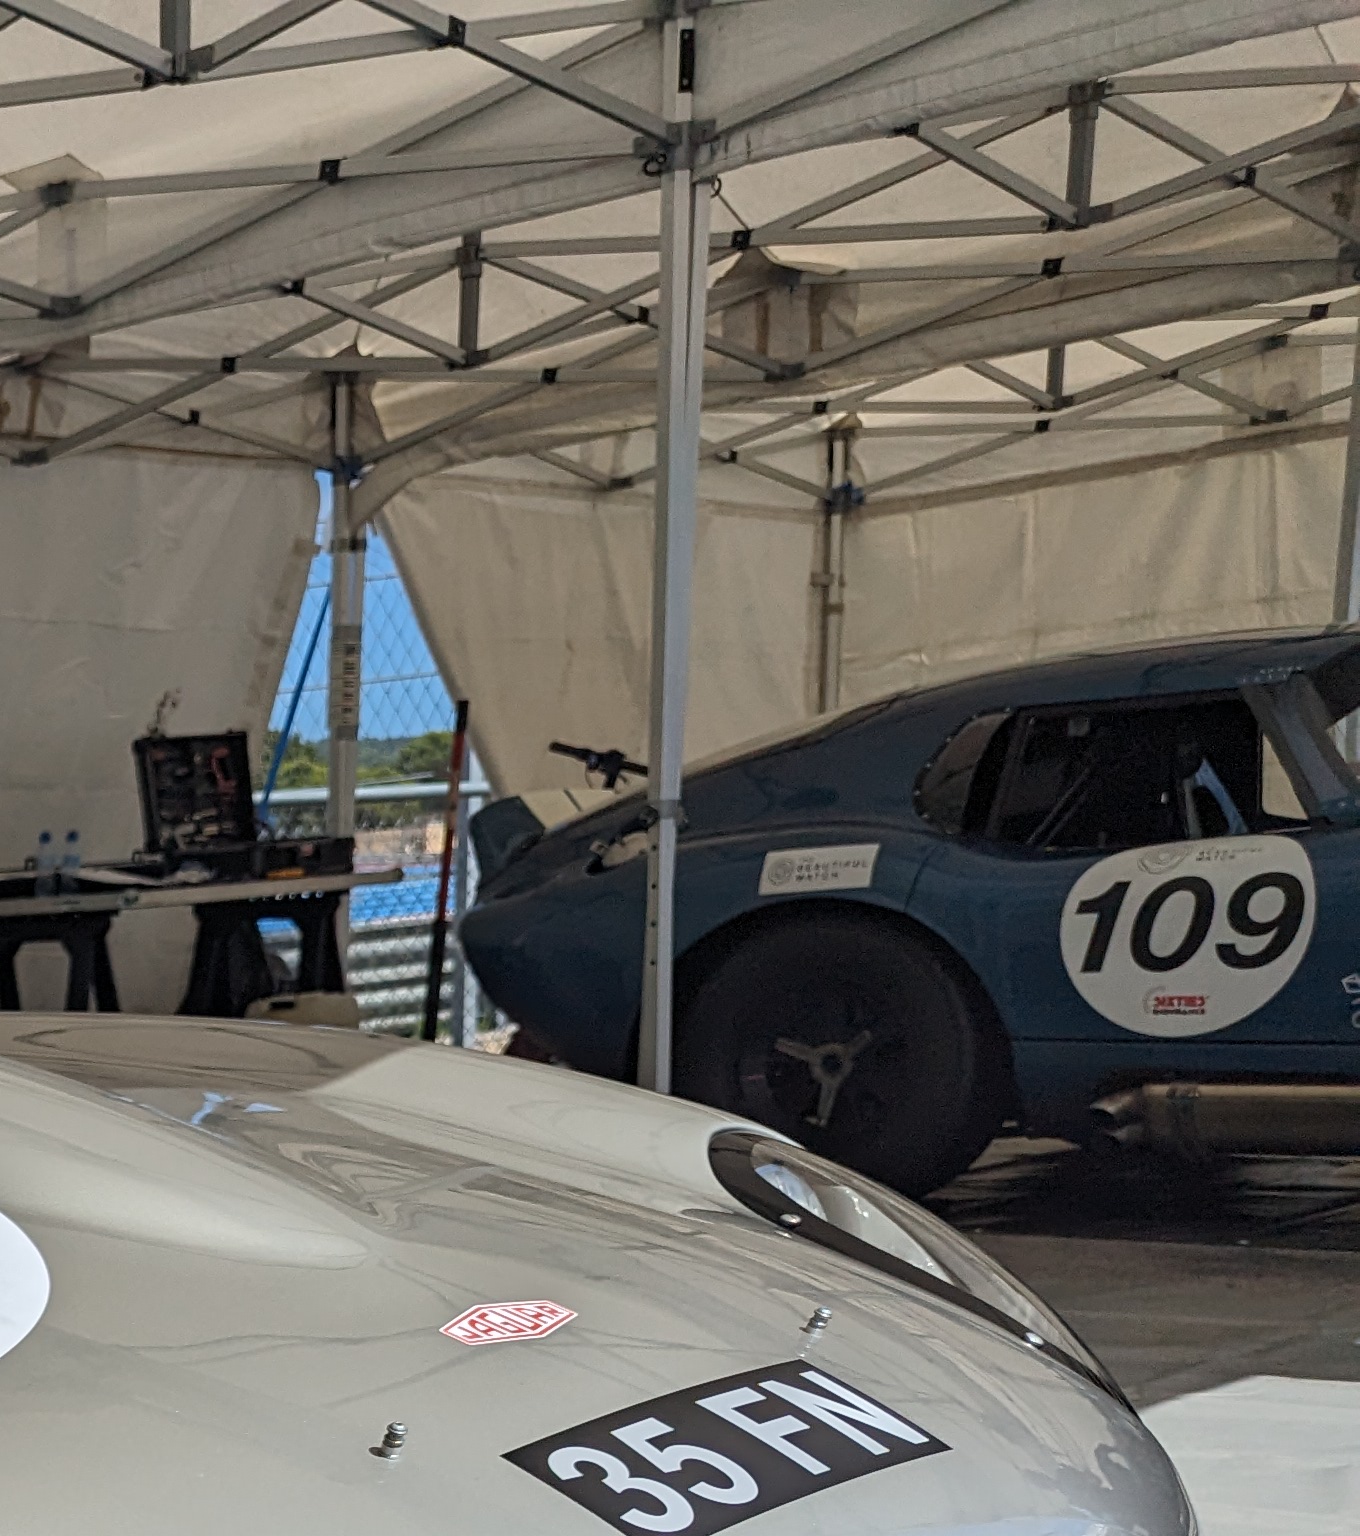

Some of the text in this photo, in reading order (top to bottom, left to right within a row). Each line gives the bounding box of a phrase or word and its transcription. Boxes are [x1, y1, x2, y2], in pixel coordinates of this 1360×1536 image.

[1074, 871, 1305, 973] 109
[457, 1305, 565, 1339] JAGUAR
[547, 1370, 930, 1533] 35 FN
